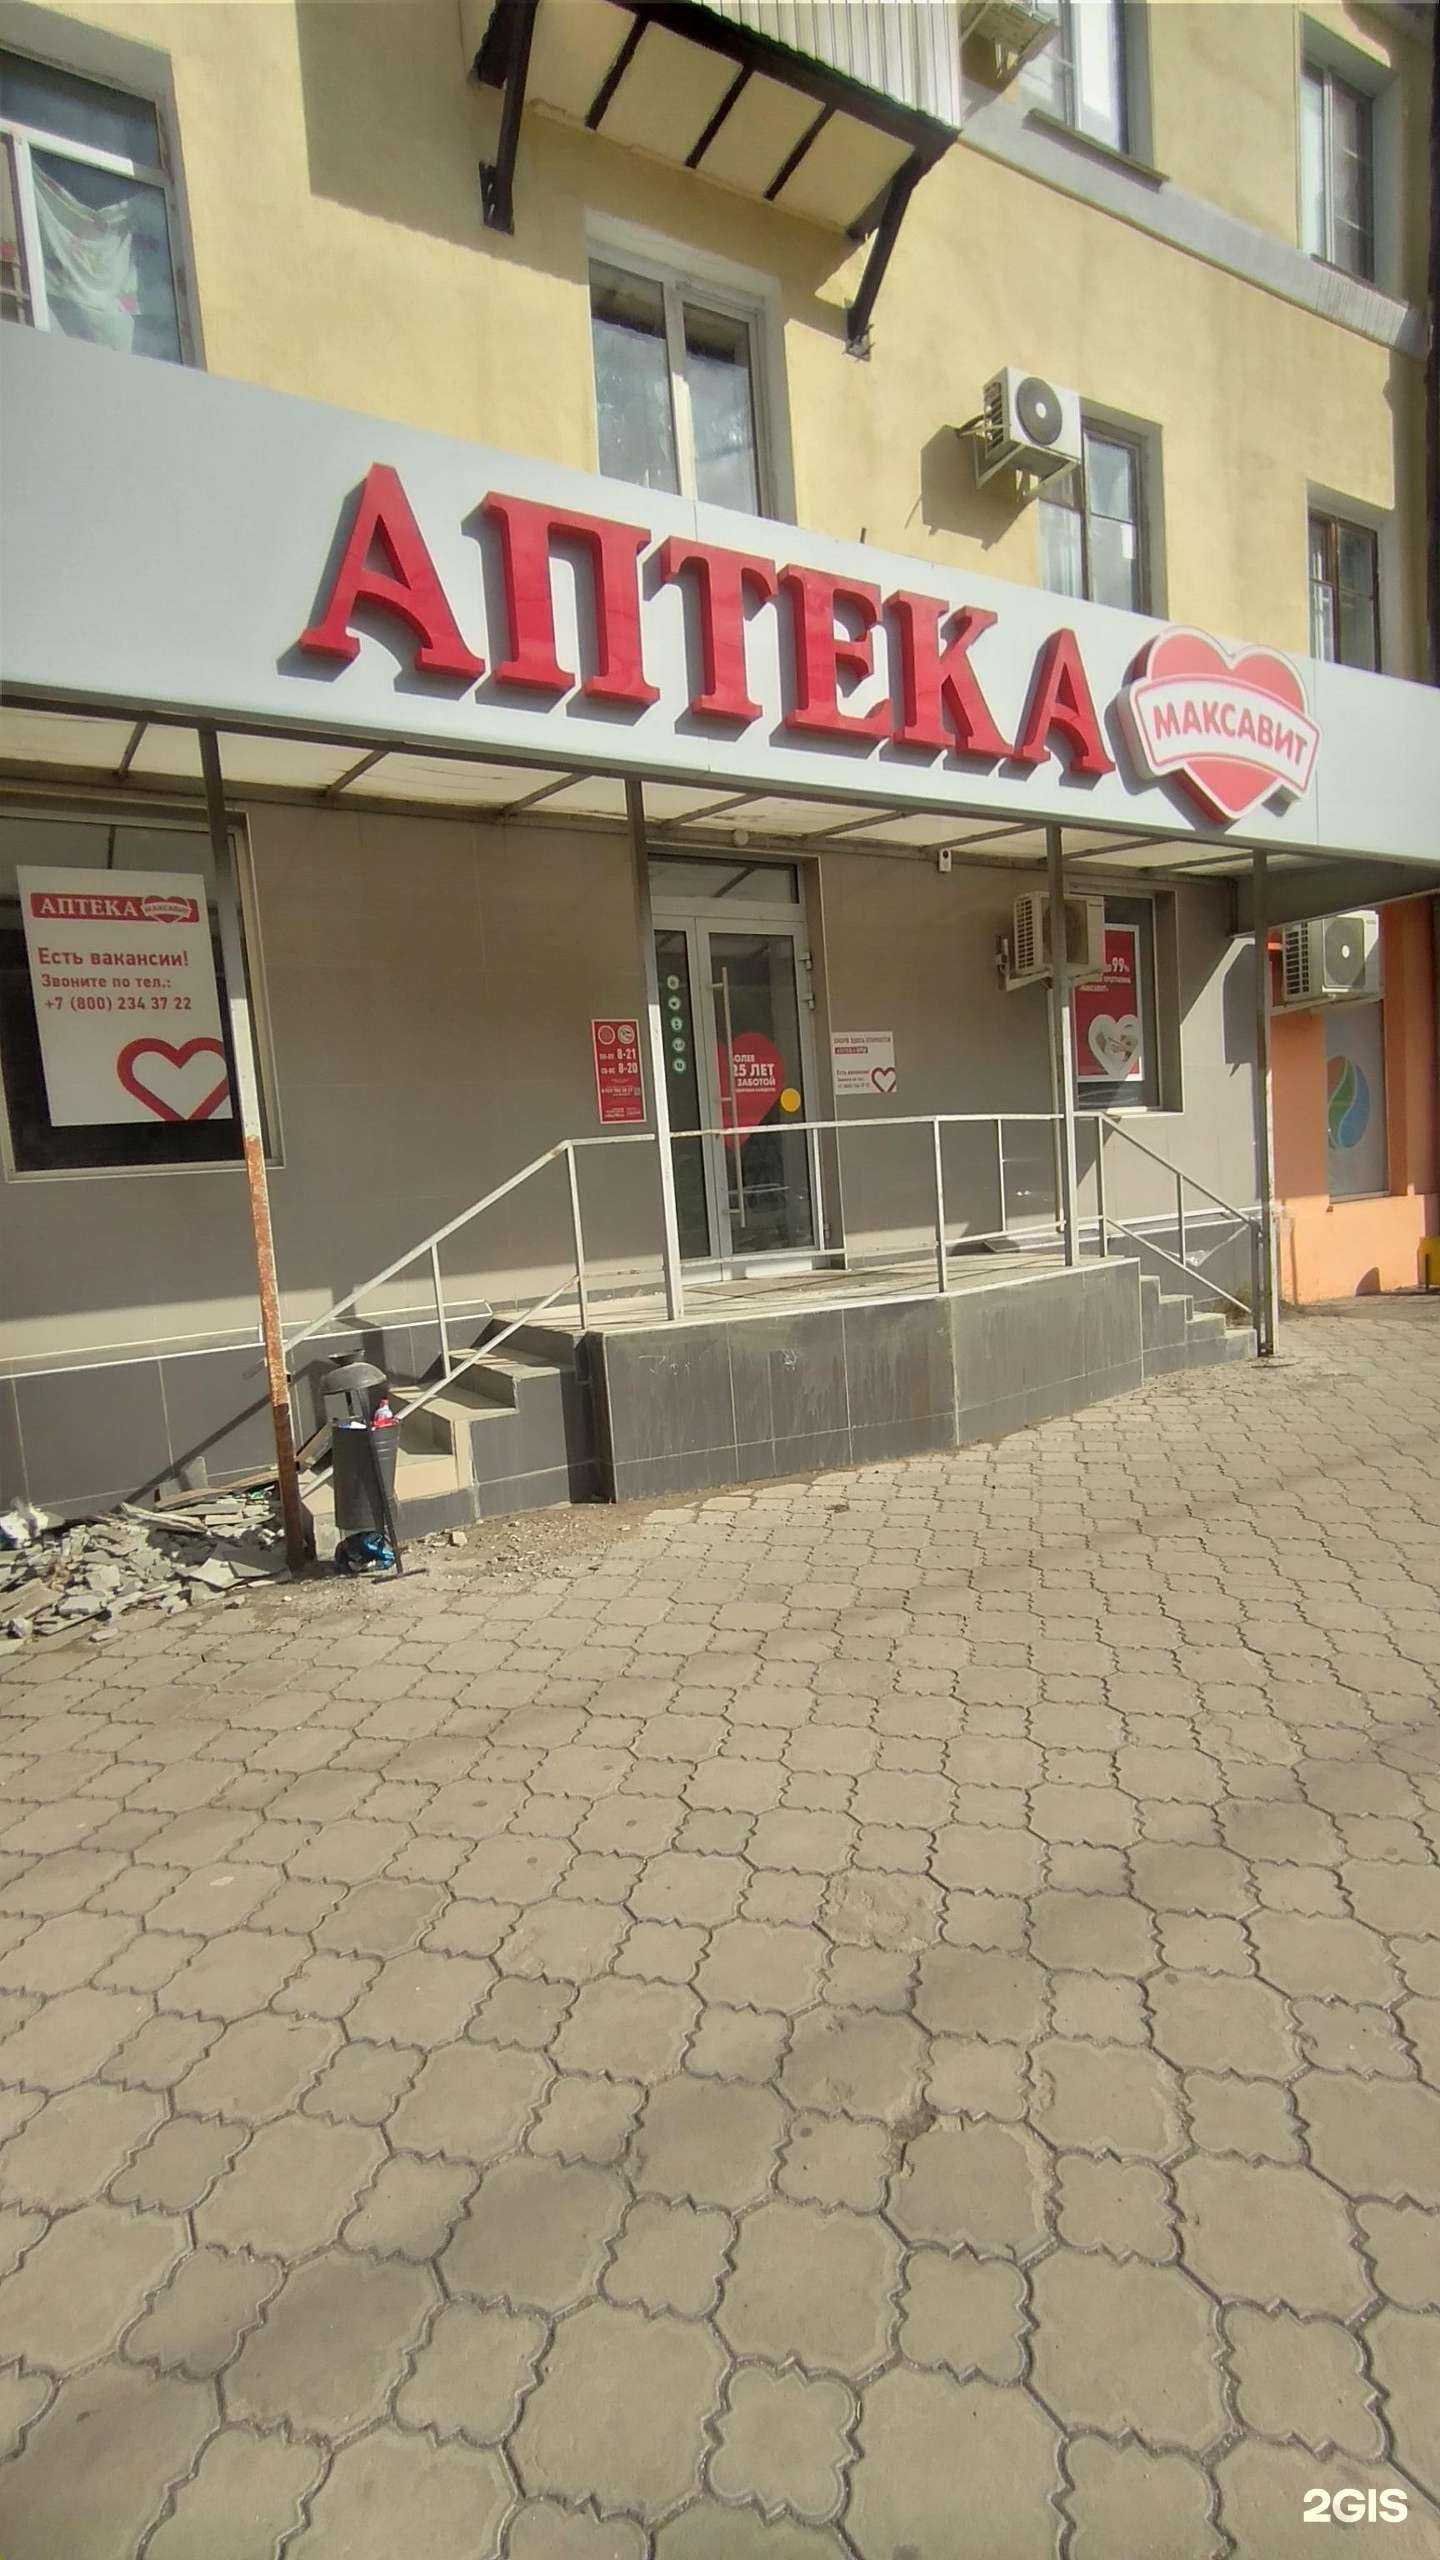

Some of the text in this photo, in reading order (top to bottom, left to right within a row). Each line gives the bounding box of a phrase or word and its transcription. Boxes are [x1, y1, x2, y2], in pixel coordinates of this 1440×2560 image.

[299, 463, 1308, 775] АПТЕКА МАКСАВИТ
[40, 898, 138, 917] АПТЕКА
[38, 947, 189, 967] Есть вакансии!
[41, 974, 171, 988] Звоните по тел.:
[45, 996, 192, 1011] +7 (800) 234 37 22
[750, 1063, 775, 1077] ЛЕТ
[737, 1076, 776, 1087] ЗАБОТОЙ
